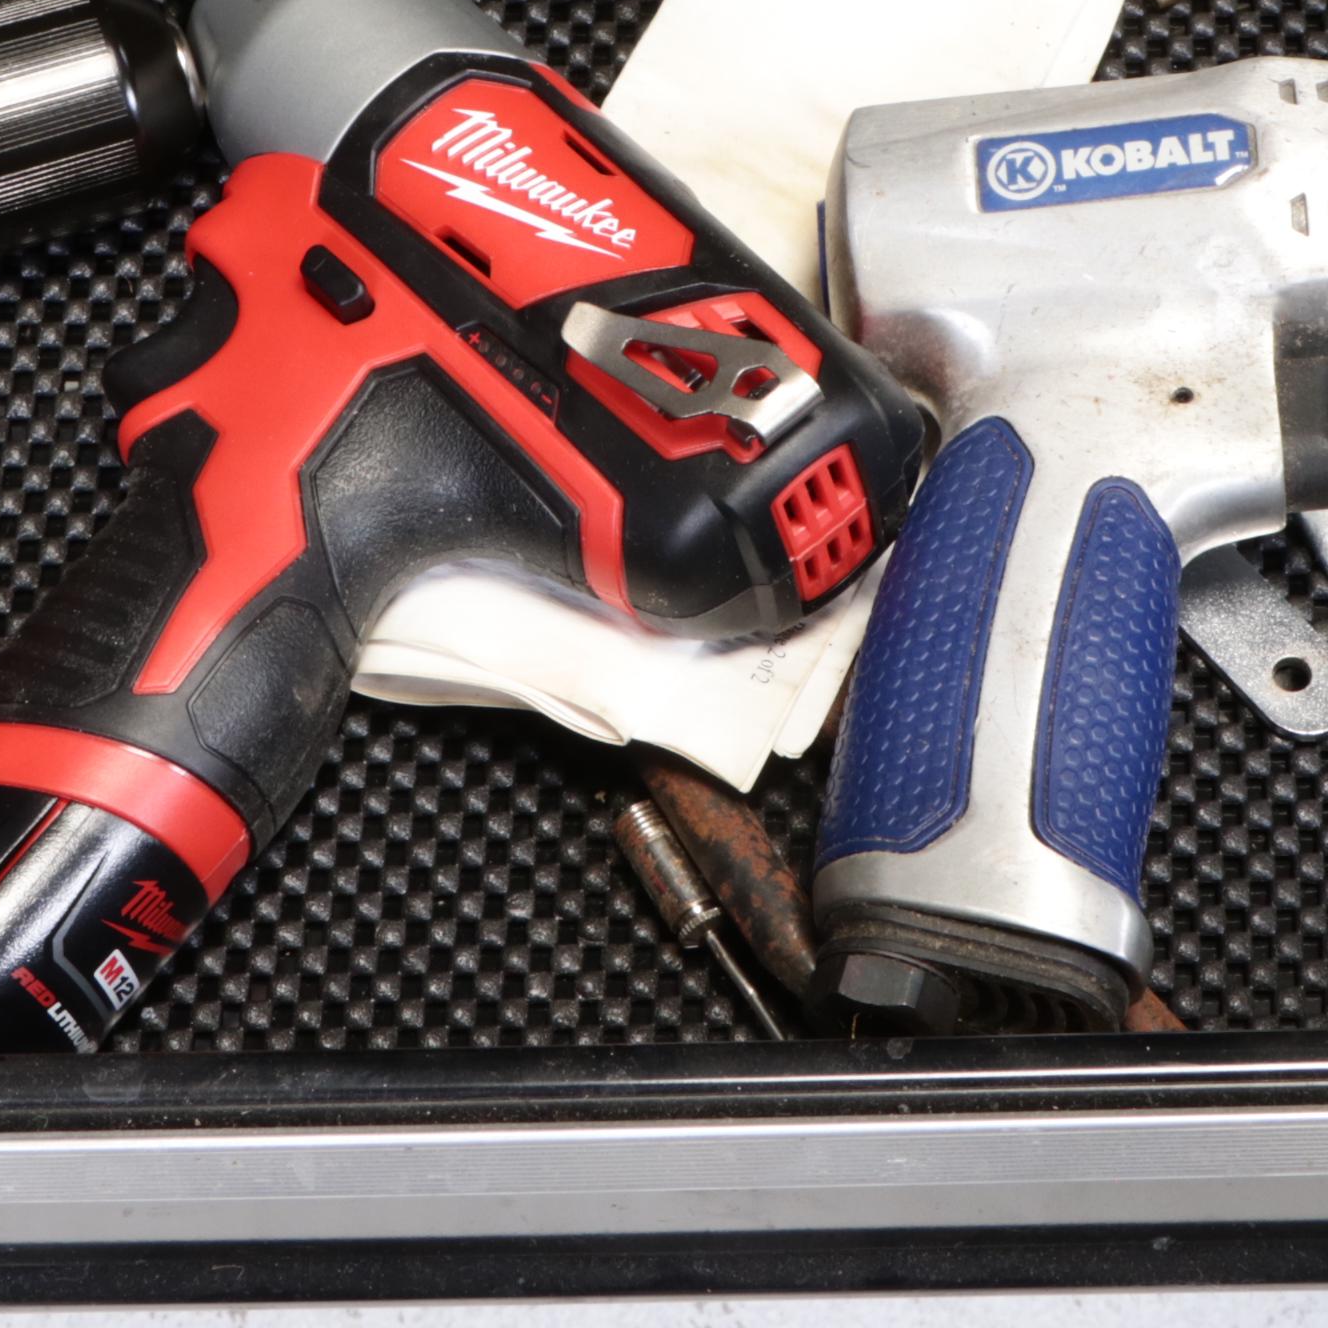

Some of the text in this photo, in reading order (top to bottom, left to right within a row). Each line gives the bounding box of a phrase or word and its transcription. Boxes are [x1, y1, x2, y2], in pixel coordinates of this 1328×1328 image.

[431, 108, 637, 250] Milwaukee
[1061, 130, 1234, 180] KOBALT
[99, 956, 135, 1003] M12
